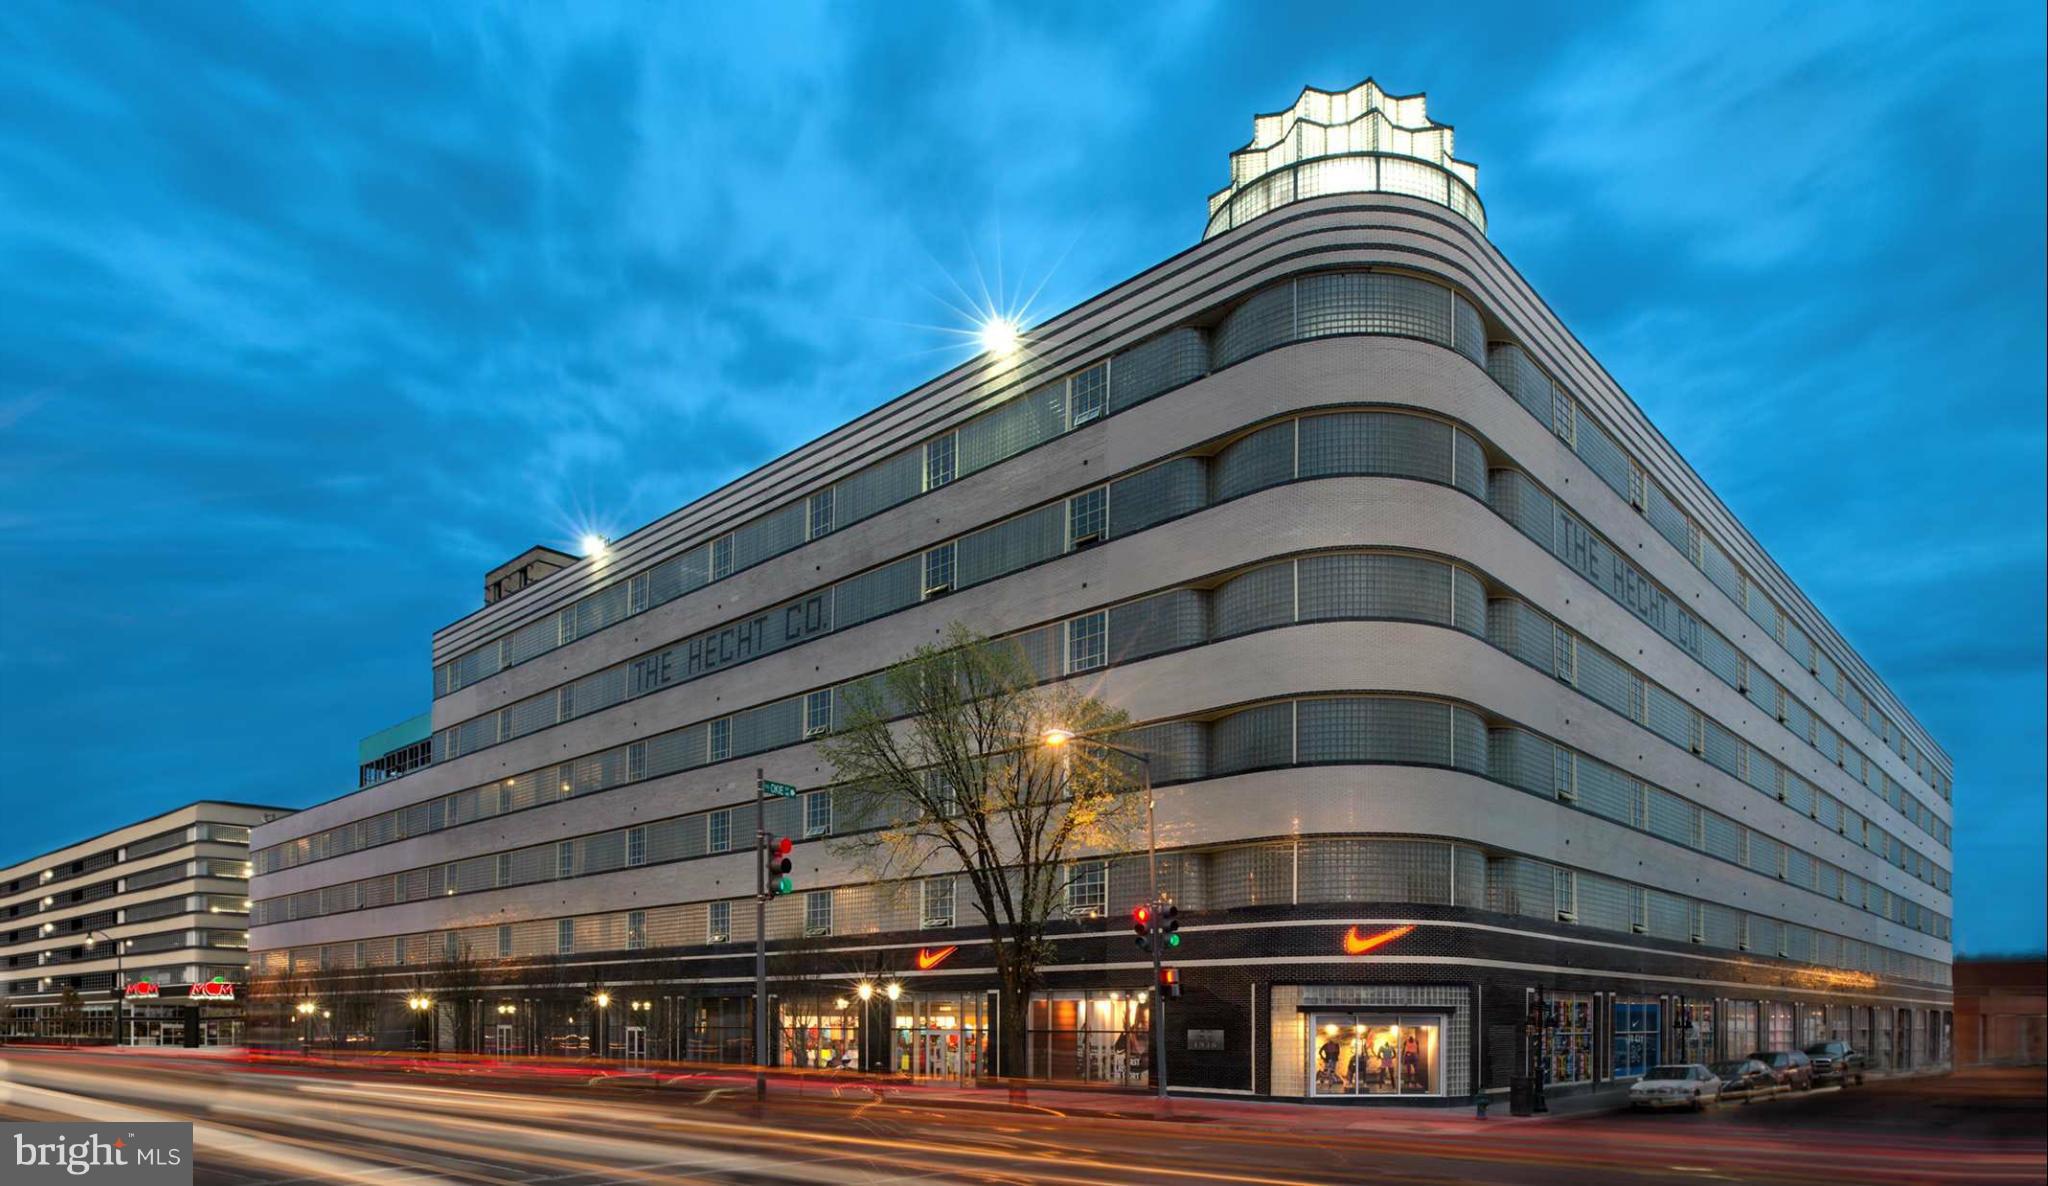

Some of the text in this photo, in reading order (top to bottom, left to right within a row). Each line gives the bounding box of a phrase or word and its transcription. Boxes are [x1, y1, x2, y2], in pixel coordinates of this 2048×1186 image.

[1562, 514, 1599, 580] THE
[1613, 555, 1668, 629] HECHT
[634, 651, 672, 692] THE
[688, 615, 768, 675] HECHT
